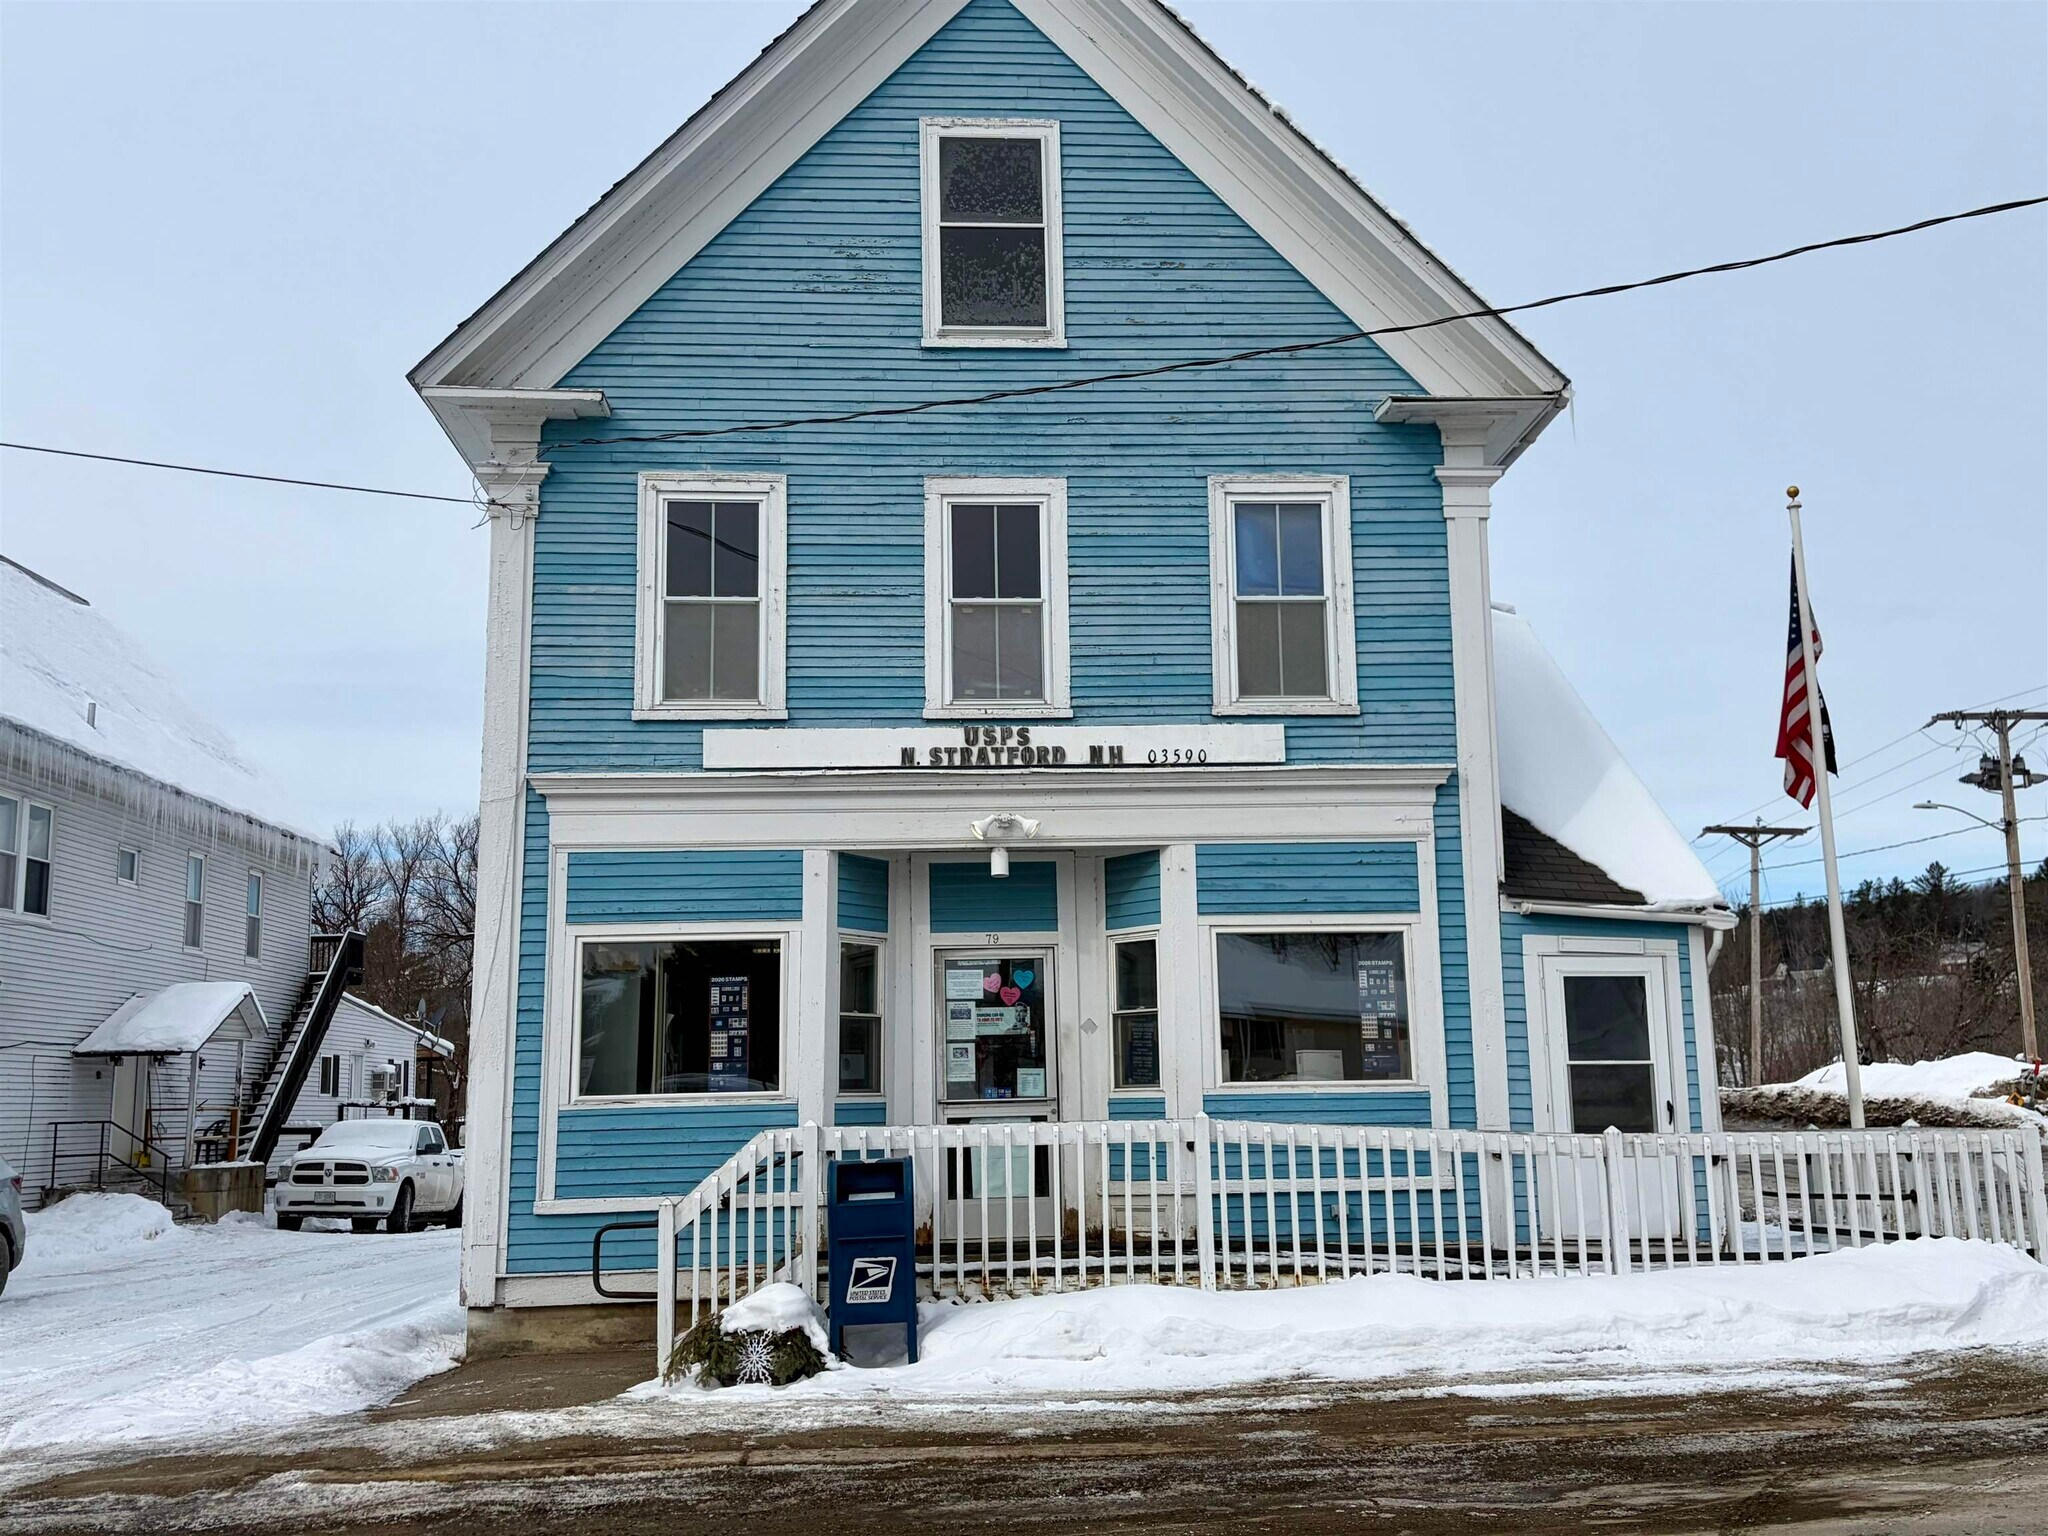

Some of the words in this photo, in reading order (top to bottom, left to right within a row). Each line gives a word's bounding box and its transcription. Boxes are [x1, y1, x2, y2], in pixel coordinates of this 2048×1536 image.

[964, 726, 1030, 746] USPS
[900, 746, 921, 766] N.
[928, 745, 1067, 766] STRATFORD
[1089, 745, 1125, 765] NH
[1148, 749, 1207, 764] 03590
[985, 934, 999, 945] 79
